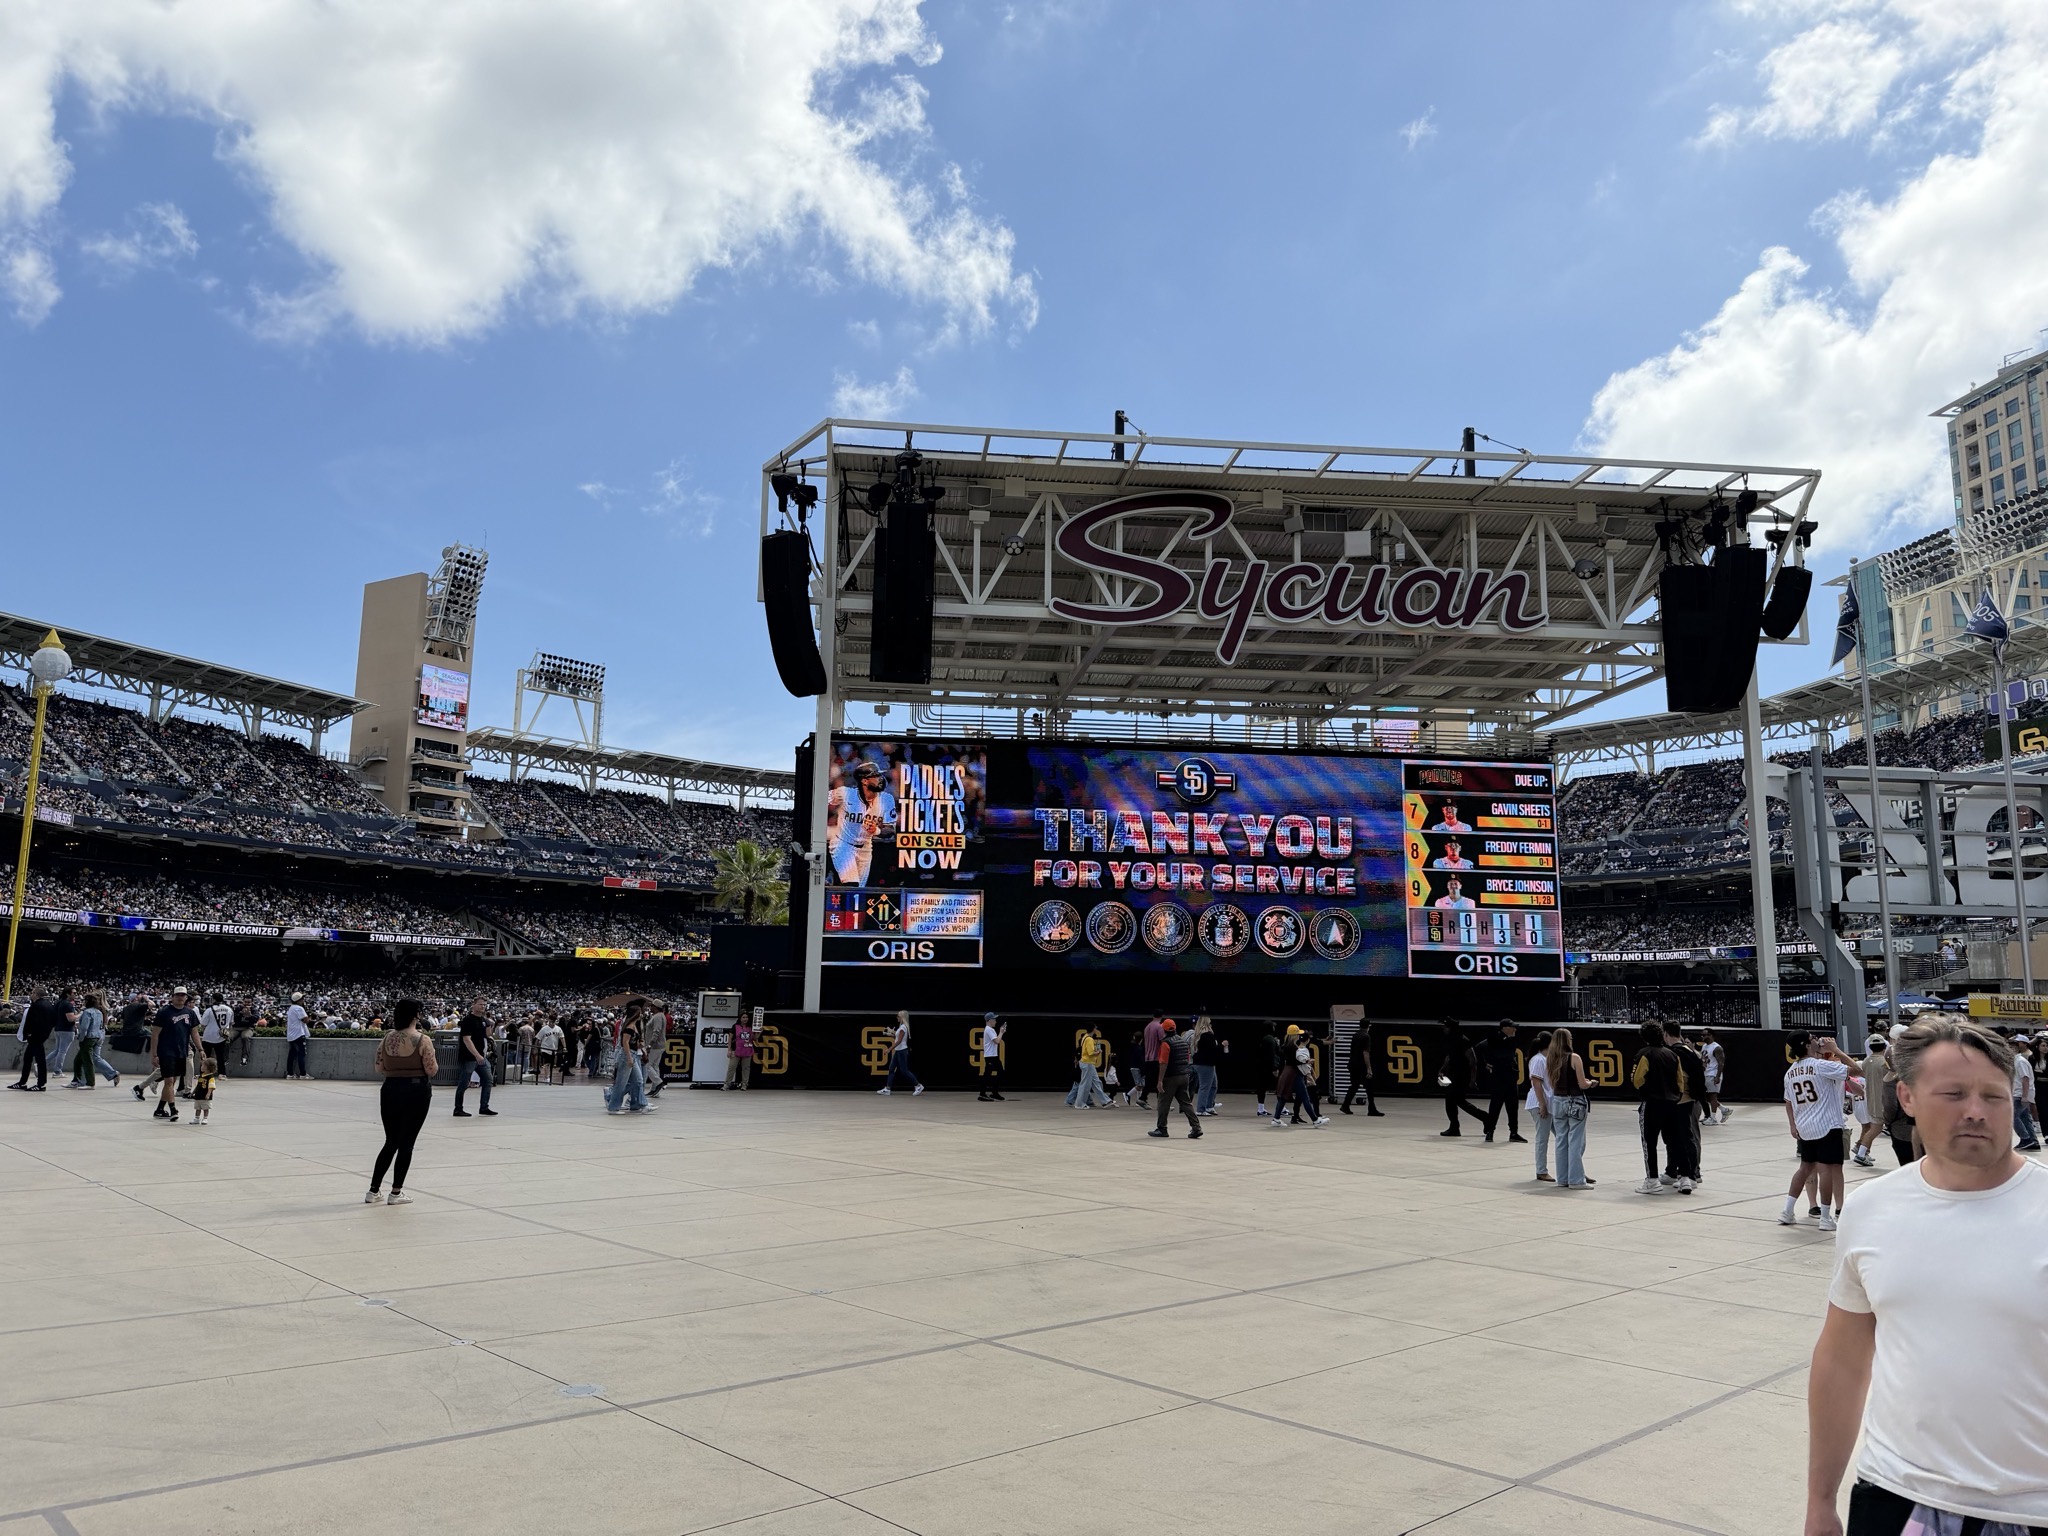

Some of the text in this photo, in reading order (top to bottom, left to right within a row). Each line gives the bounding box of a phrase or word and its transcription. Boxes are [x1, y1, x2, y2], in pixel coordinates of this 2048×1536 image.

[1049, 491, 1548, 666] Sycuan
[900, 764, 965, 800] PADRES
[1515, 774, 1548, 787] DUE UP:
[899, 799, 965, 833] TICKETS
[1410, 803, 1418, 819] 7
[1491, 803, 1551, 816] GAVIN SHEETS
[1537, 819, 1547, 828] 0-1
[900, 835, 963, 848] ON SALE
[1034, 808, 1353, 860] THANK YOU
[1411, 843, 1419, 860] 8
[1485, 841, 1552, 854] FREDDY FERMIN
[899, 849, 962, 869] NOW
[1539, 858, 1549, 866] 0-1
[1033, 859, 1357, 896] FOR YOUR SERVICE
[1412, 880, 1420, 897] 9
[1486, 879, 1554, 893] BRYCE JOHNSON
[853, 893, 859, 911] 1
[910, 898, 920, 906] HIS
[921, 898, 940, 906] FAMILY
[953, 899, 977, 907] FRIENDS
[25, 908, 34, 918] BE
[35, 909, 77, 922] RECOGNIZED
[853, 912, 859, 930] 1
[910, 915, 934, 923] WITNESS
[945, 916, 957, 924] MLB
[958, 916, 977, 924] DEBUT
[1464, 913, 1472, 927] 0
[1498, 914, 1504, 929] 1
[1530, 915, 1535, 929] 1
[151, 920, 279, 936] STAND AND BE RECOGNIZED
[1448, 920, 1520, 936] R H E
[369, 933, 465, 946] STAND AND BE RECOGNIZED
[1465, 929, 1471, 943] 1
[1498, 930, 1506, 944] 3
[1530, 931, 1538, 945] 0
[868, 940, 934, 960] ORIS
[1591, 951, 1690, 962] STAND AND BE RECOGNIZED
[1781, 944, 1797, 954] AND
[1798, 944, 1807, 953] BE
[1455, 954, 1518, 974] ORIS
[705, 1033, 716, 1044] 50
[665, 1038, 690, 1073] SD
[1387, 1035, 1423, 1083] SD
[1589, 1040, 1624, 1087] SD
[1793, 1080, 1818, 1105] 23
